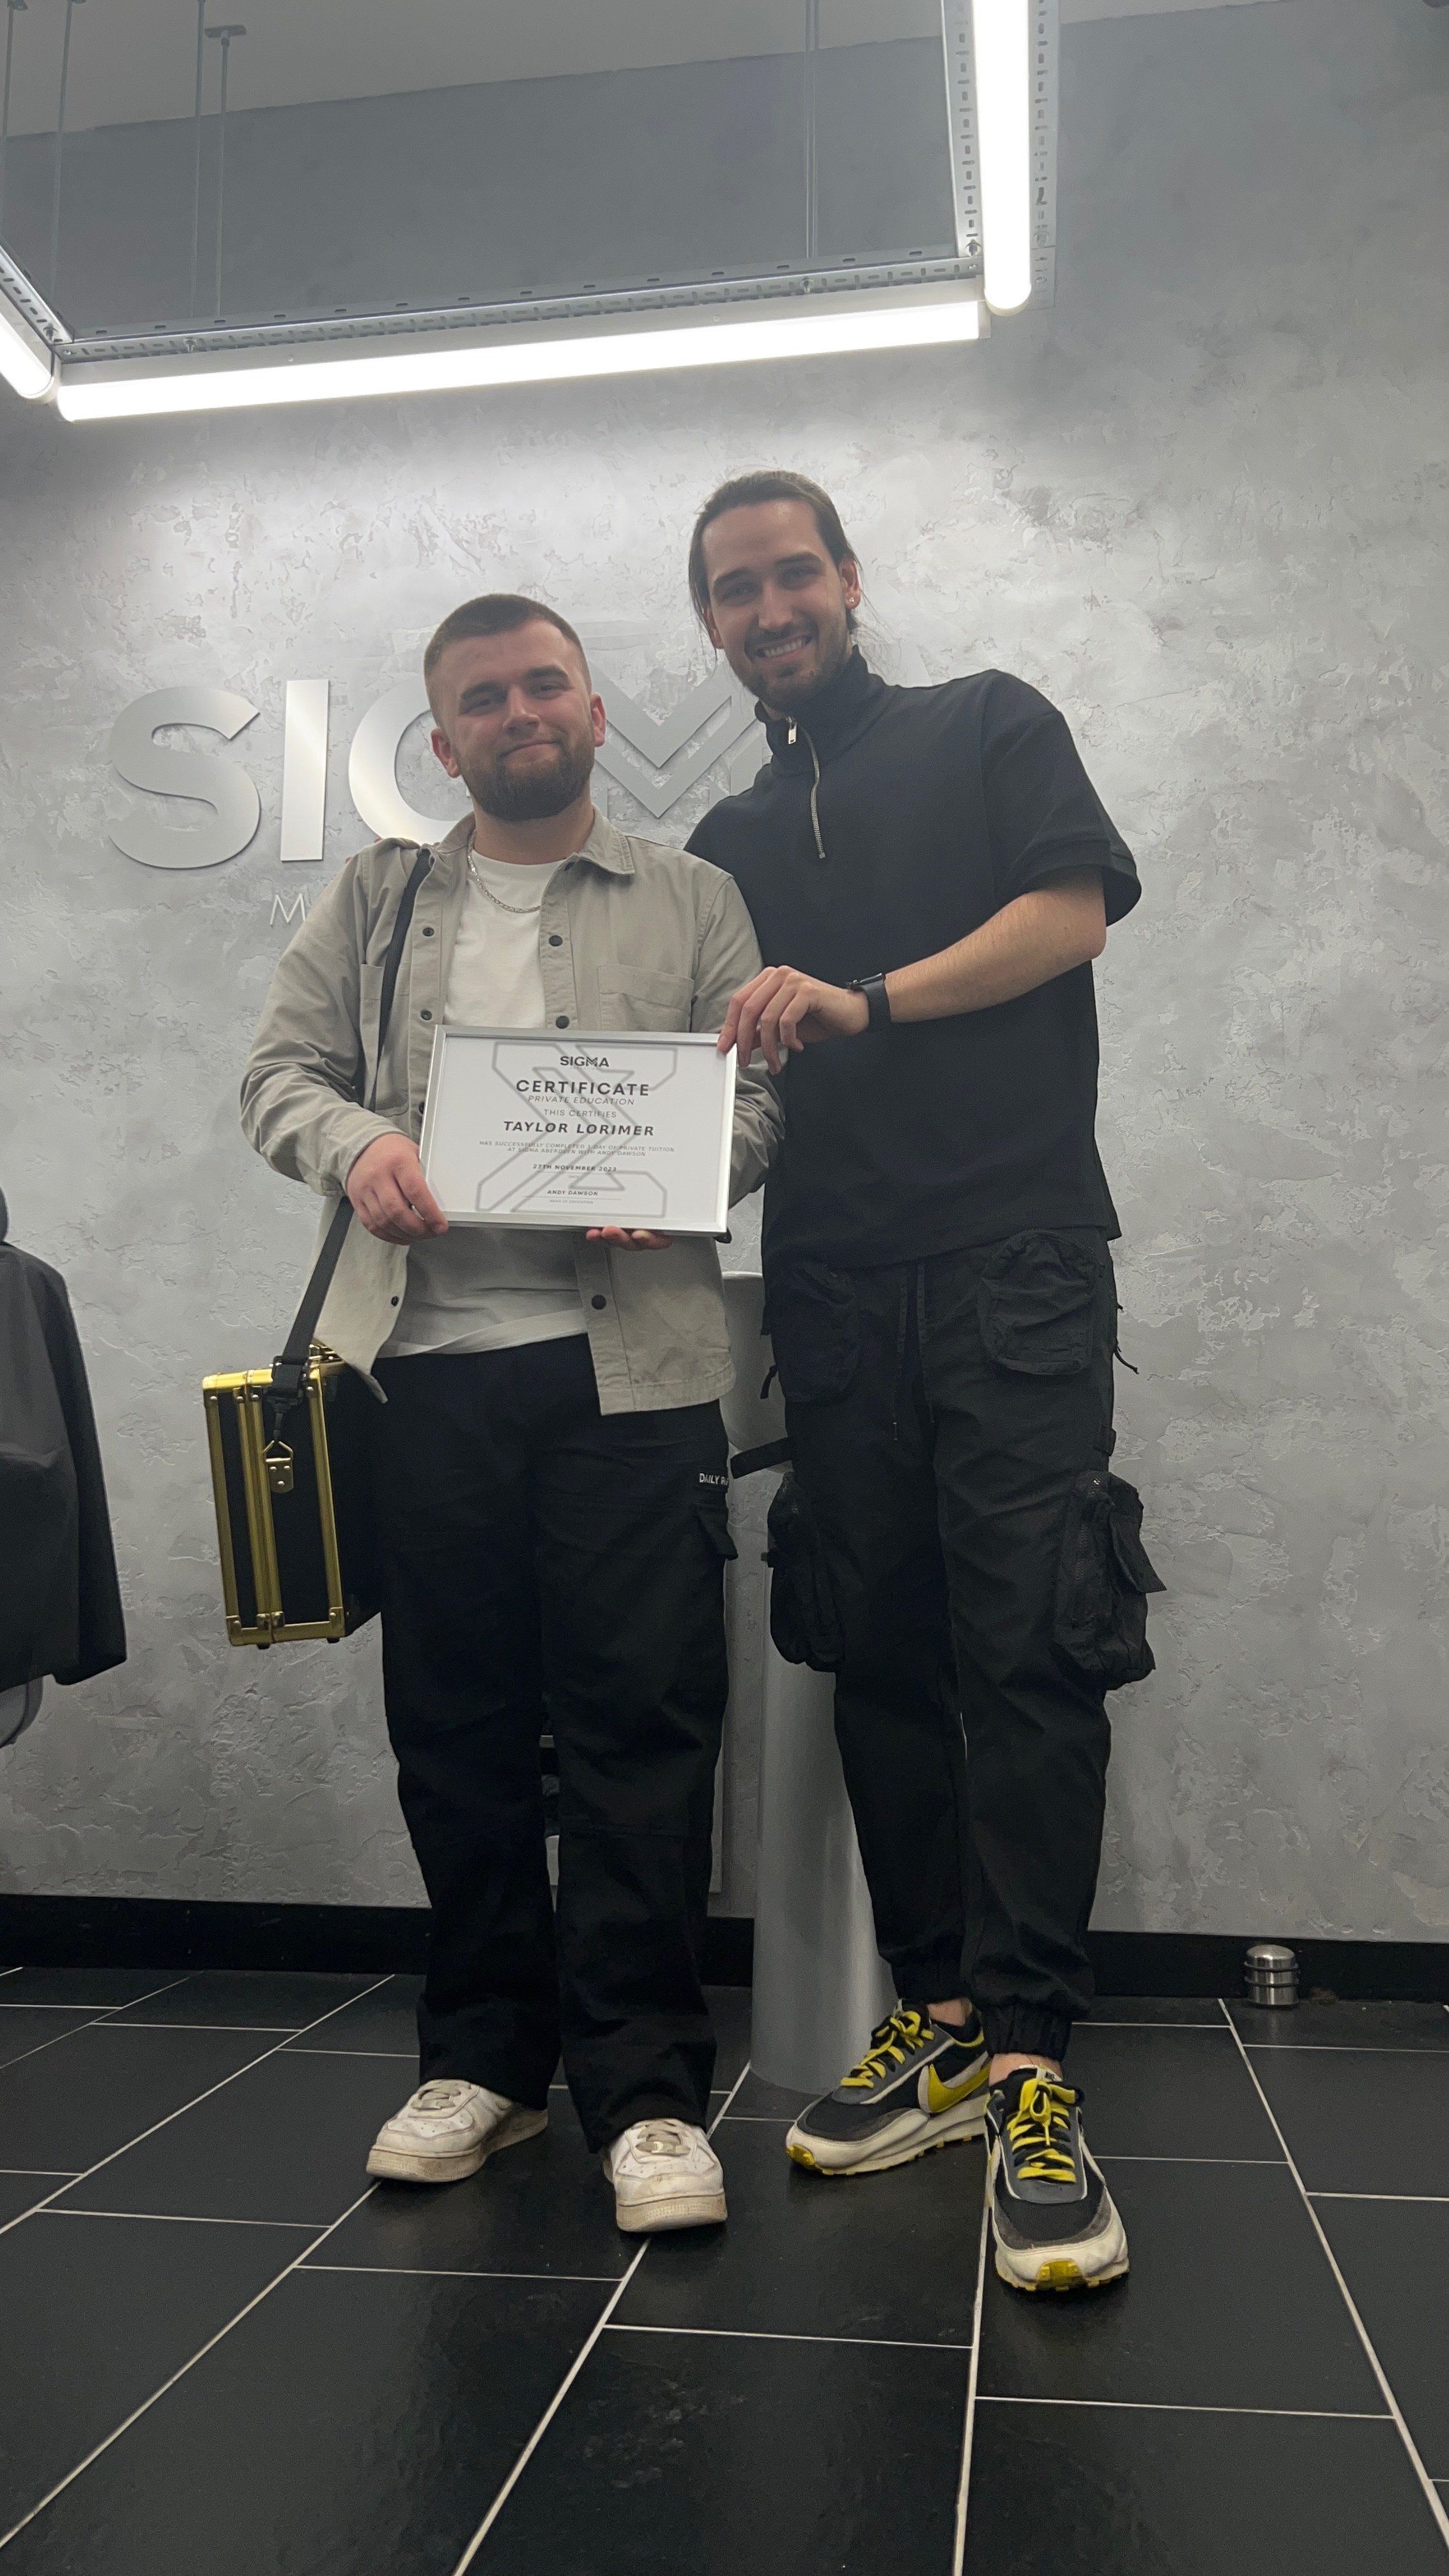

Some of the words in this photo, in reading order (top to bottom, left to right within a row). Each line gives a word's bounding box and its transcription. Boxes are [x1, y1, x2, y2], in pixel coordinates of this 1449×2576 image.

[560, 1056, 610, 1068] SIGMA
[516, 1080, 649, 1096] CERTIFICATE
[528, 1095, 569, 1103] PRIVATE
[574, 1097, 635, 1105] EDUCATION
[569, 1110, 617, 1118] CERTIFIES
[503, 1121, 568, 1133] TAYLOR
[576, 1124, 654, 1136] LORIMER
[700, 1473, 719, 1485] DAILY
